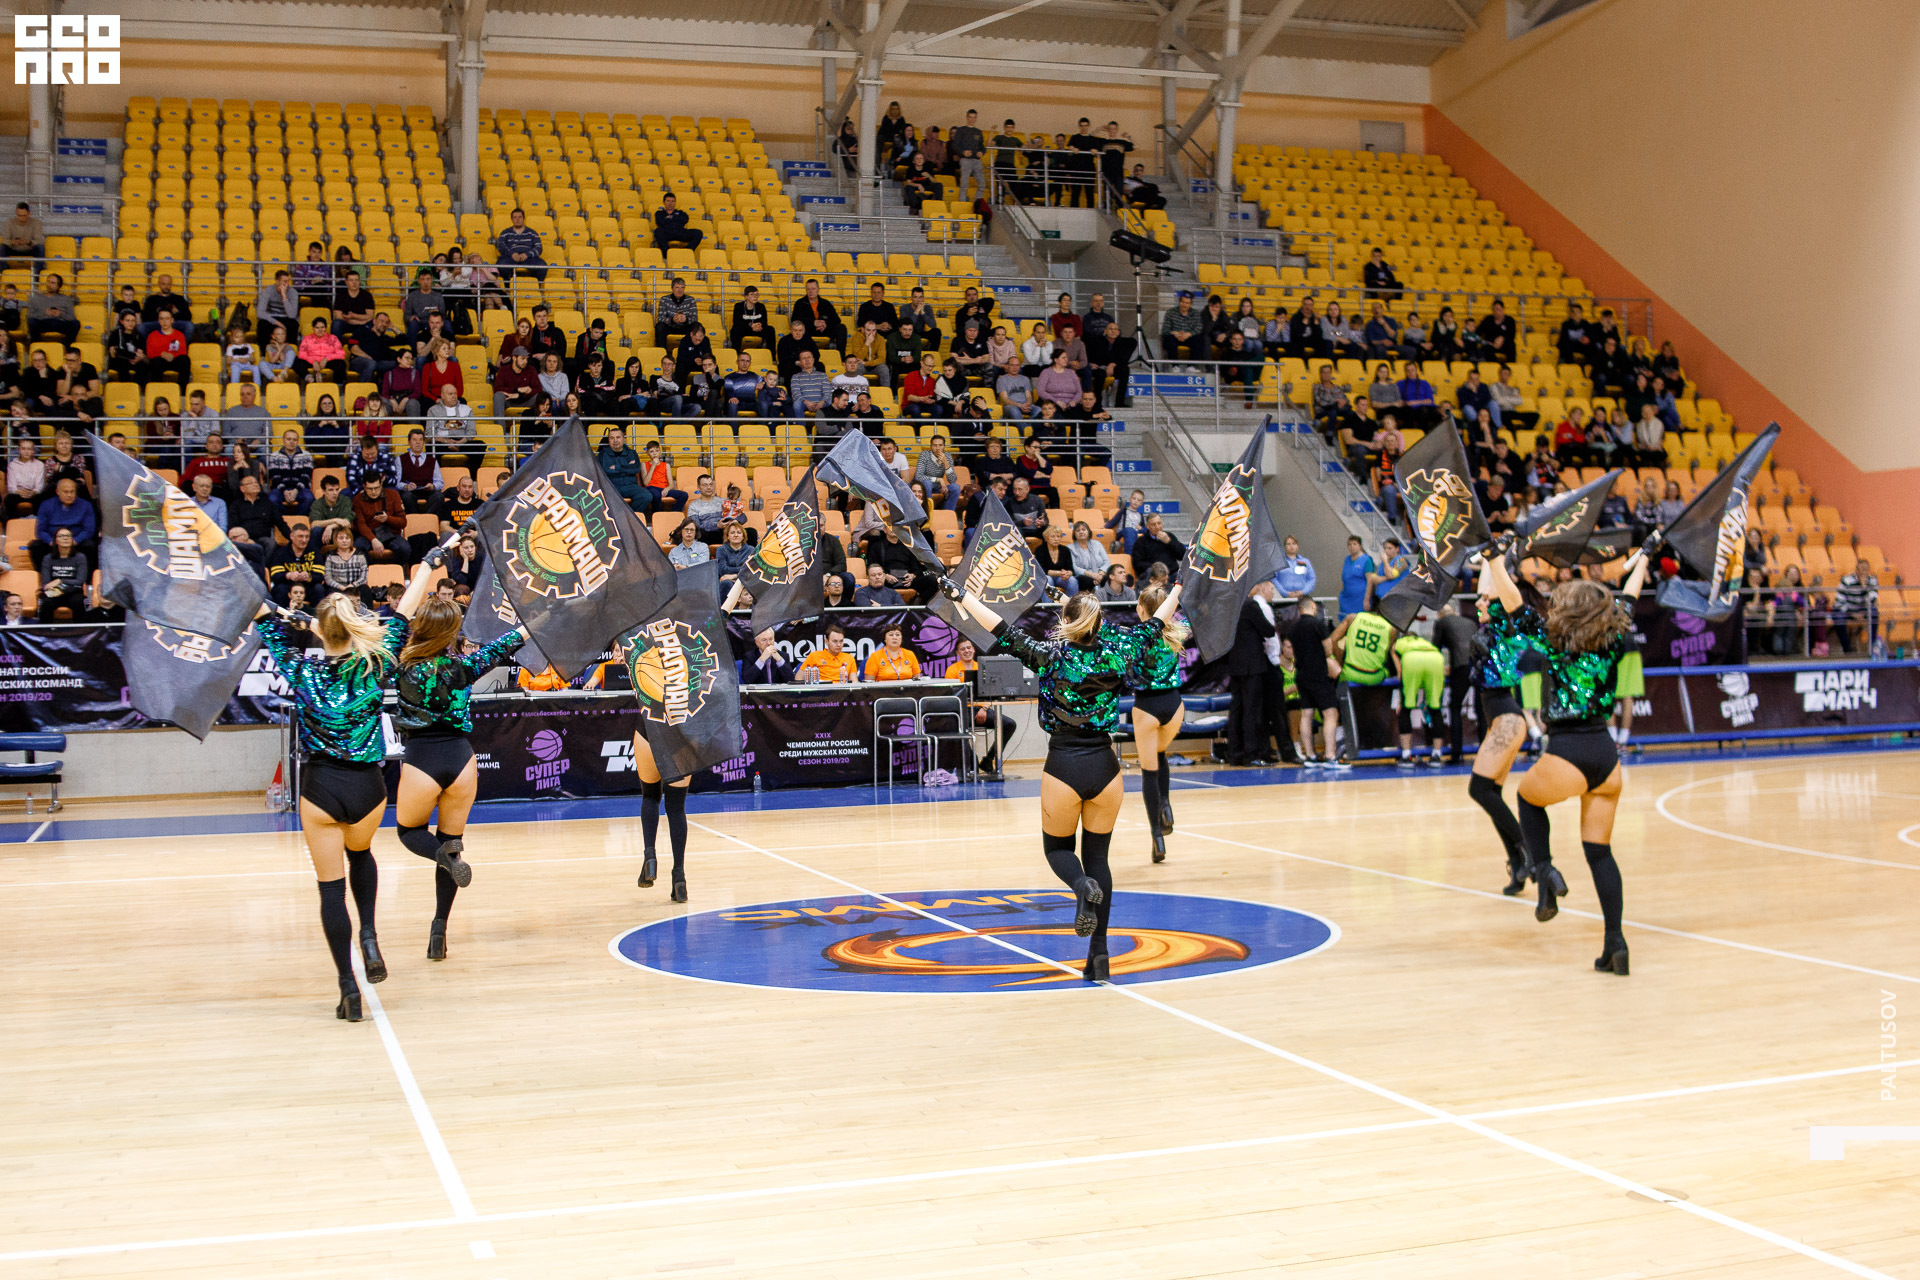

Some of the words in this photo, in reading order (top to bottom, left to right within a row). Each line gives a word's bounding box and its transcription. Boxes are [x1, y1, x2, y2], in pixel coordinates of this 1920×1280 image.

[1102, 423, 1108, 431] 6
[1128, 463, 1135, 472] 5
[1156, 504, 1163, 513] 4
[517, 477, 608, 597] УРАЛМАШ
[1212, 480, 1250, 582] РАЛМАШ
[770, 511, 806, 584] РАЛМАШ
[1355, 629, 1381, 653] 98
[22, 666, 69, 676] РОССИИ
[647, 618, 690, 726] УРАЛМАШ
[35, 679, 84, 689] КОМАНД
[1803, 669, 1870, 693] ПАРИ
[9, 692, 53, 702] 2019/20
[1812, 688, 1877, 712] МАТЧ
[787, 740, 829, 748] ЧЕМПИОНАТ
[779, 750, 802, 758] СРЕДИ
[803, 749, 837, 757] МУЖСКИХ
[838, 747, 868, 756] КОМАНД
[525, 758, 570, 782] СУПЕР
[722, 769, 746, 783] ЛИГА
[536, 776, 561, 791] ЛИГА
[718, 891, 1077, 921] UMMC
